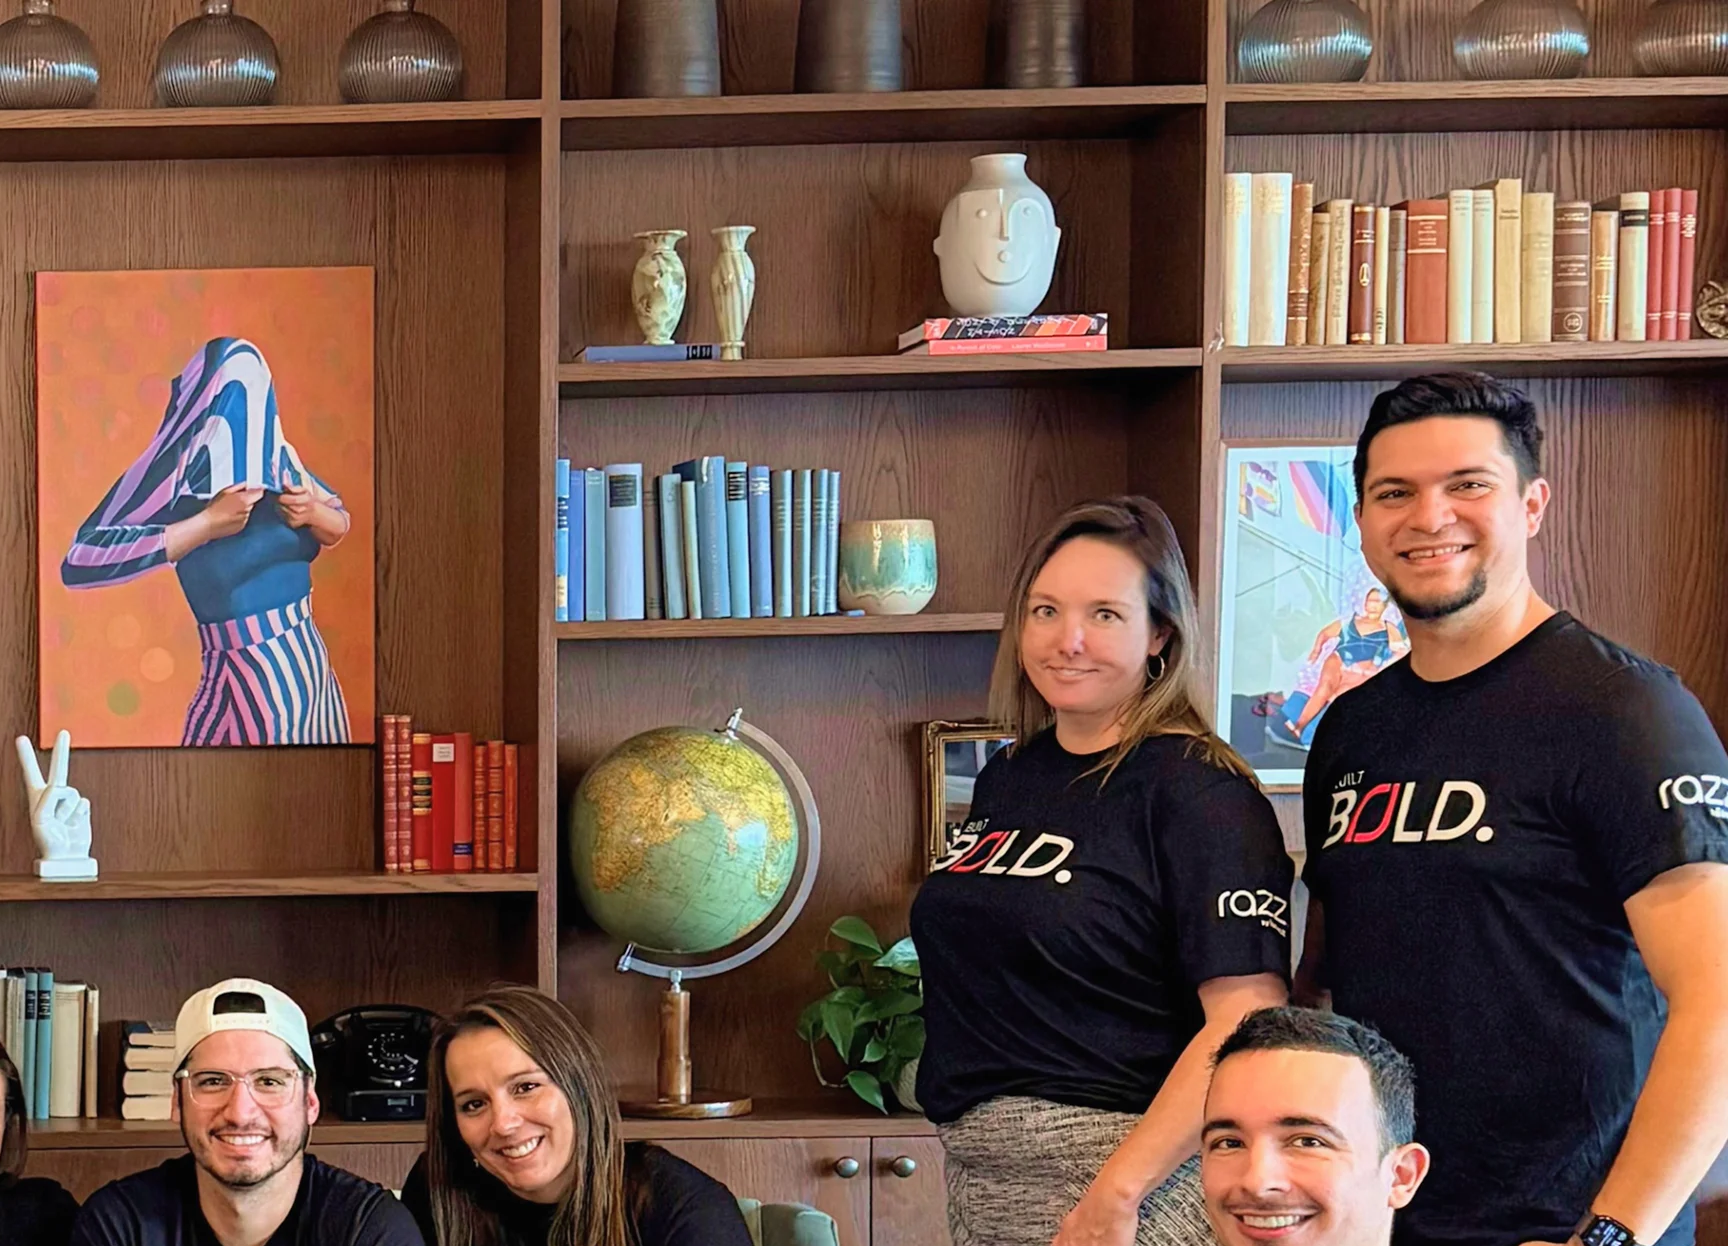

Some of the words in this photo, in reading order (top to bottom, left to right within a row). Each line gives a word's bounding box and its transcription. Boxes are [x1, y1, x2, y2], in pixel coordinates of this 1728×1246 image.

[1322, 780, 1494, 850] BOLD.
[930, 829, 1075, 884] BOLD.
[1218, 889, 1288, 926] razz
